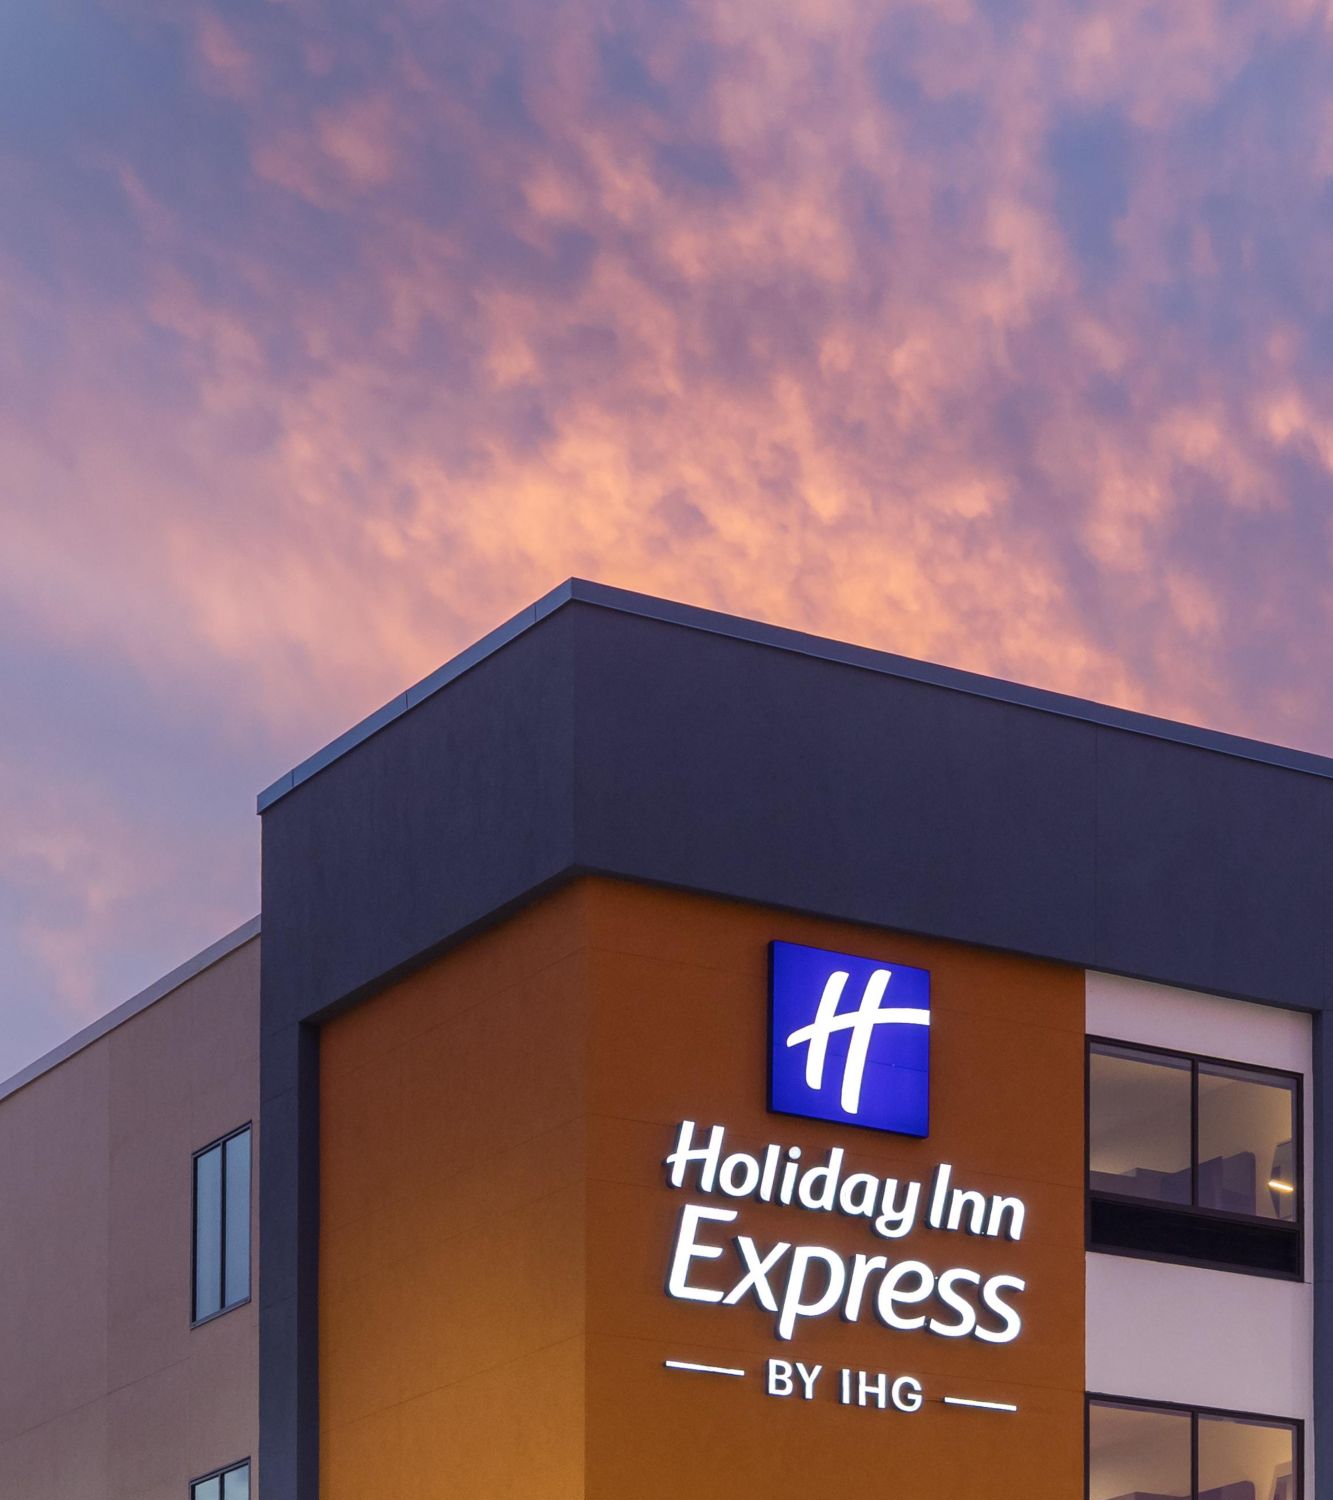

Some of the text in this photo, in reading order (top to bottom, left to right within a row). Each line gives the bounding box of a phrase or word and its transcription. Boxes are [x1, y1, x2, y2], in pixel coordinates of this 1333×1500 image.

[666, 1119, 1026, 1241] Holiday Inn
[668, 1203, 1026, 1343] Express
[768, 1358, 923, 1412] BY IHG
